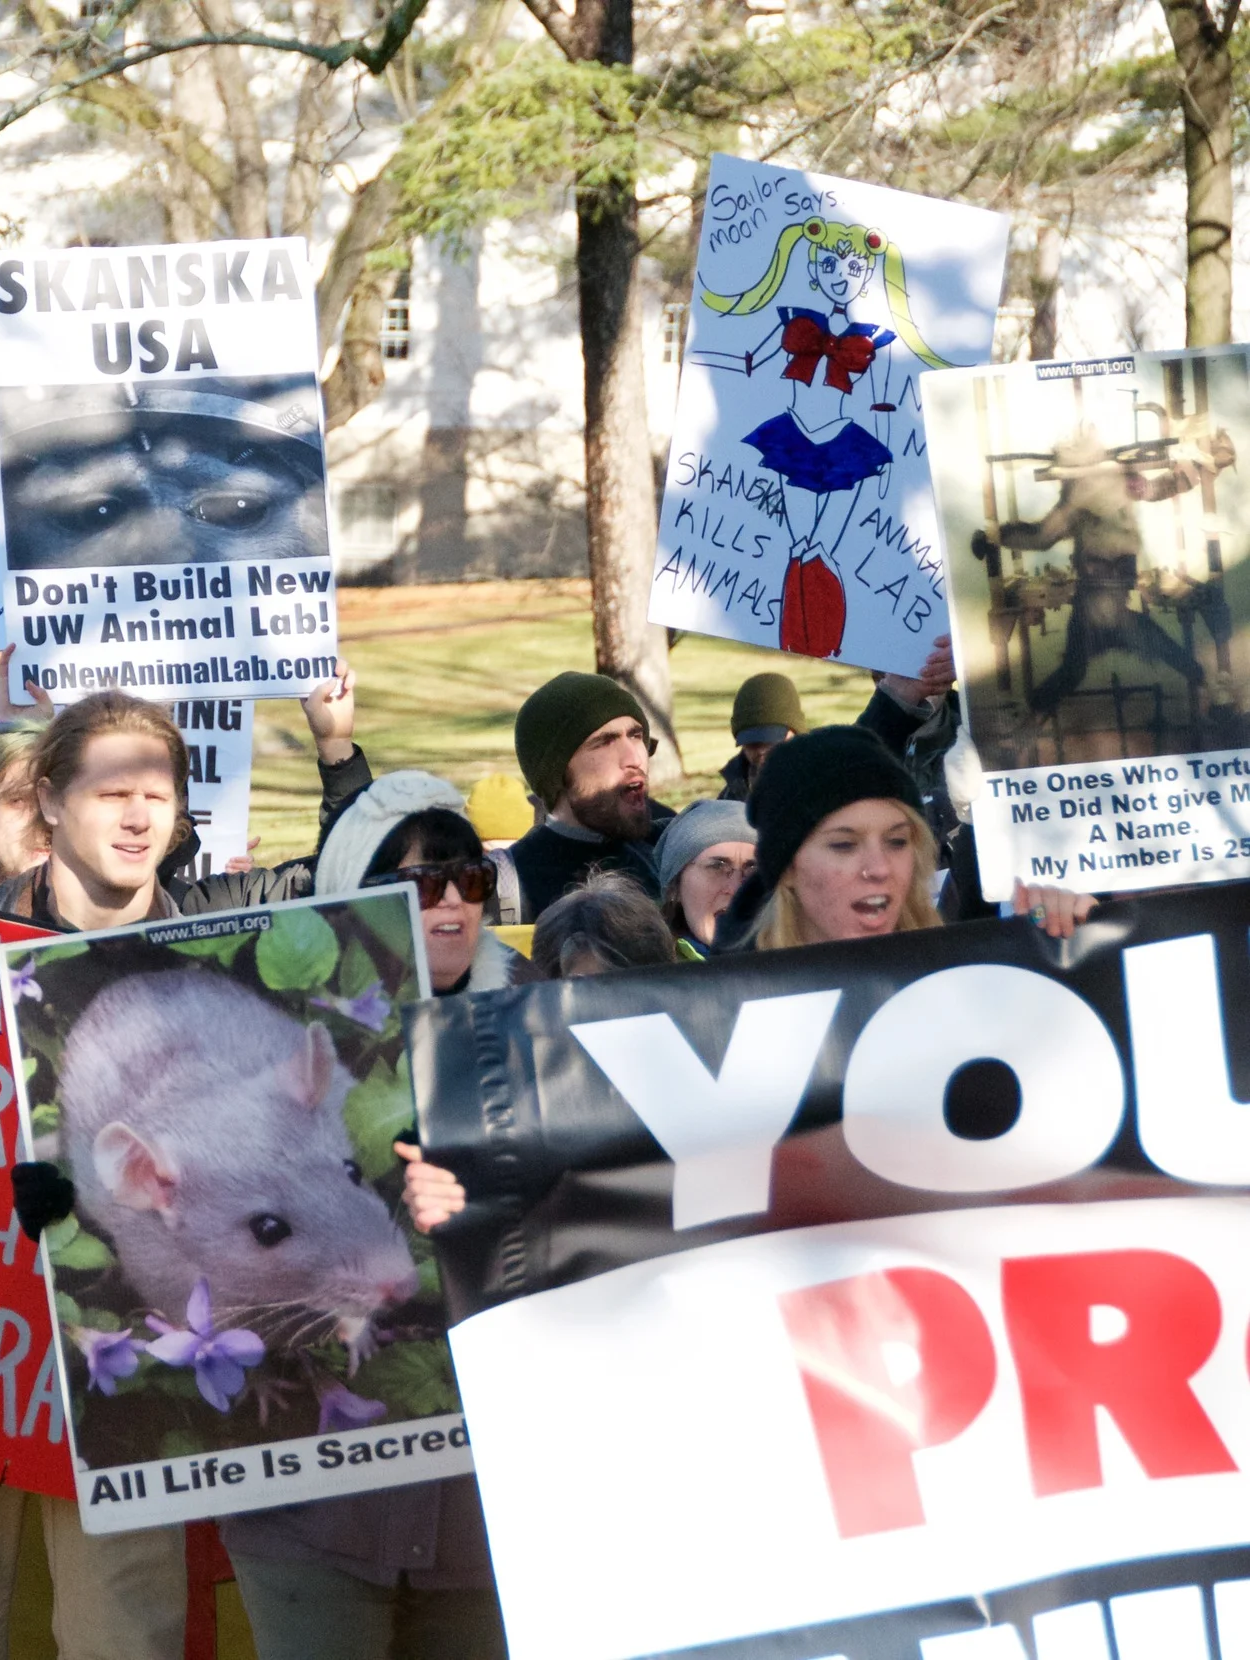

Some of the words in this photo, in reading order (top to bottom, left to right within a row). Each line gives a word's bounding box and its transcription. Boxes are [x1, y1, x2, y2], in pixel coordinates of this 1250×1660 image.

[711, 175, 786, 221] Sailor
[709, 207, 768, 253] moon
[91, 317, 219, 376] USA
[1037, 359, 1134, 379] www.faunnj.org
[675, 498, 771, 558] KILLS
[14, 572, 118, 606] Don't
[133, 565, 232, 603] Build
[247, 565, 331, 597] New
[655, 545, 782, 626] ANIMALS
[854, 547, 932, 633] LAB
[23, 613, 85, 646] UW
[100, 606, 235, 643] Animal
[249, 600, 331, 637] Lab!
[21, 654, 338, 691] NoNewAnimalLab.com
[171, 701, 243, 731] ING
[987, 777, 1037, 798] The
[1047, 772, 1114, 793] Ones
[1122, 764, 1179, 785] Who
[1011, 802, 1050, 823] Me
[1060, 797, 1102, 818] Did
[1111, 793, 1158, 814] Not
[1168, 788, 1221, 814] give
[1089, 824, 1107, 843] A
[1116, 820, 1199, 841] Name.
[1031, 856, 1068, 880] My
[1078, 847, 1181, 872] Number
[1191, 843, 1214, 861] Is
[149, 915, 271, 944] www.faunnj.org
[569, 932, 1250, 1231] YOU
[778, 1248, 1250, 1540] PR
[89, 1469, 146, 1506] All
[162, 1457, 246, 1494] Life
[262, 1449, 302, 1479] Is
[316, 1418, 471, 1471] Sacred
